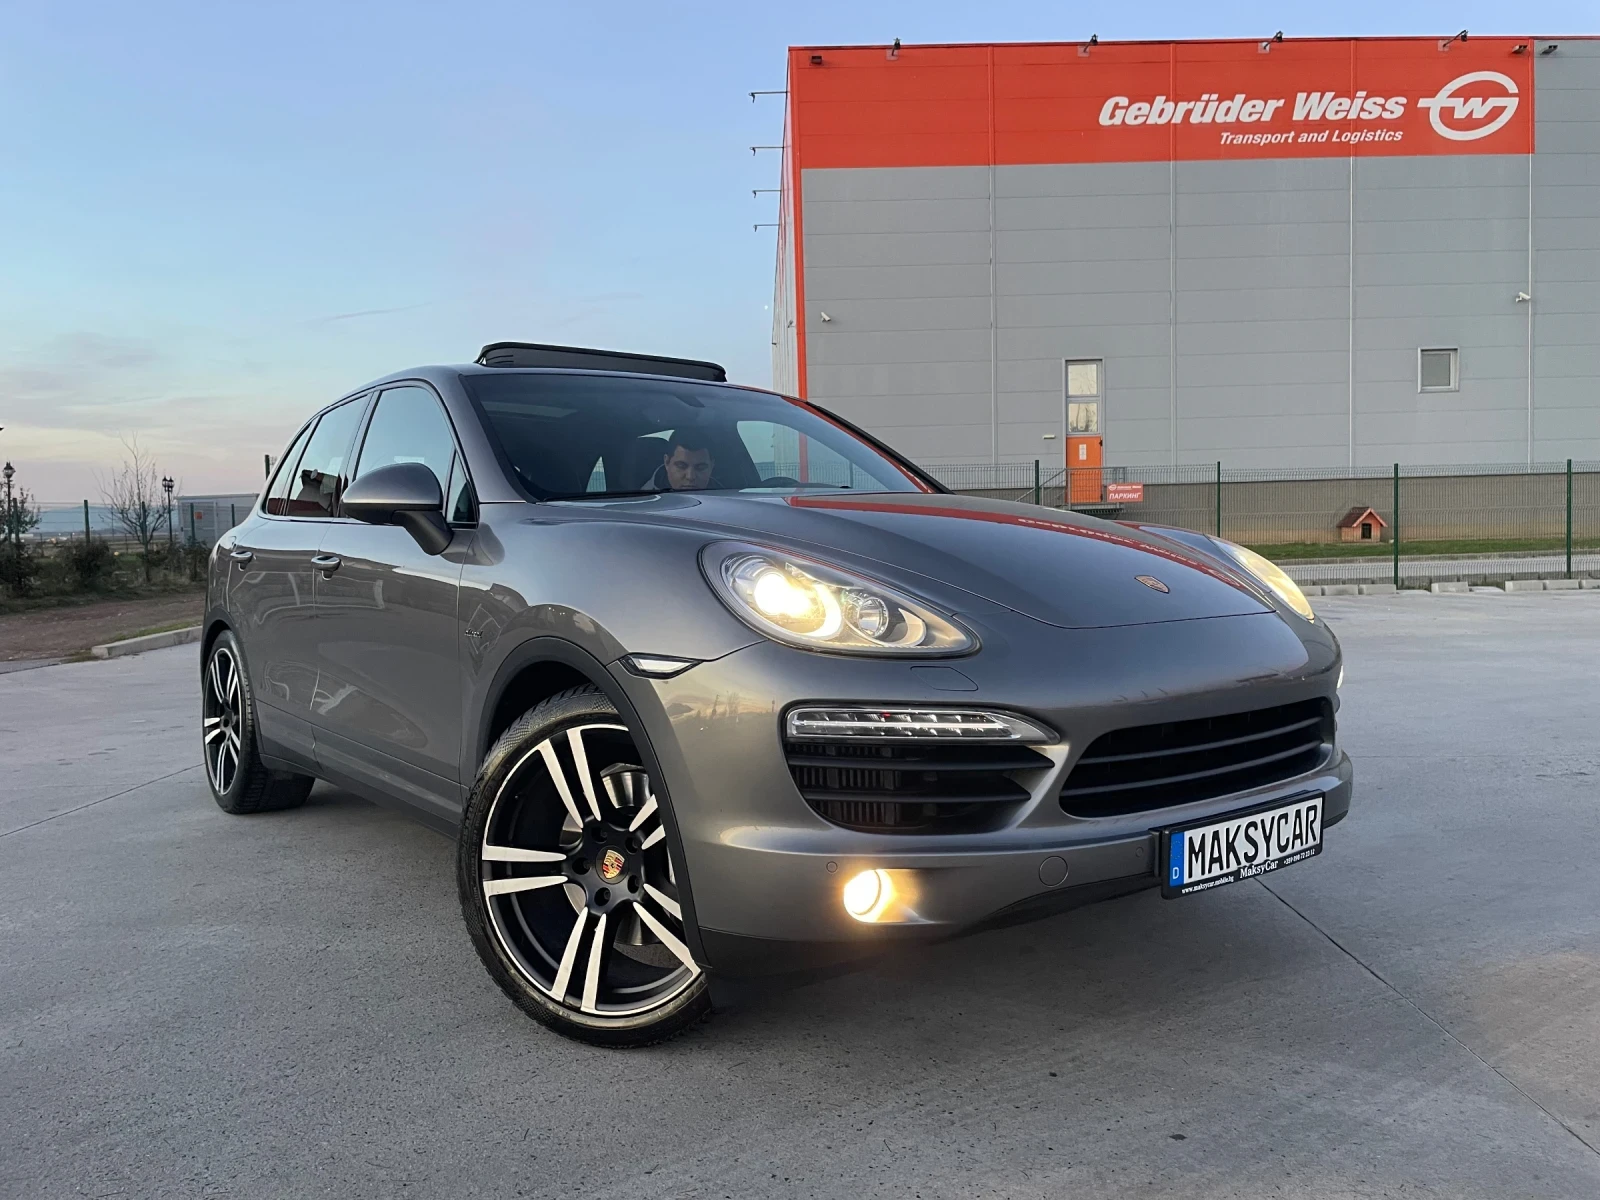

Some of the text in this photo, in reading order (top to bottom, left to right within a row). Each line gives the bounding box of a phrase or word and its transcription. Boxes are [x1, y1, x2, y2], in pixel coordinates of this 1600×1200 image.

[1099, 91, 1407, 126] Gebrüder Weiss
[1220, 127, 1404, 147] Transport and Logistics
[1109, 492, 1142, 500] ПАРКИНГ
[1188, 804, 1318, 879] MAKSYCAR
[1172, 867, 1180, 880] D
[1240, 860, 1279, 879] MaksyCar
[1181, 875, 1235, 894] www.maksycar.mobile.bg
